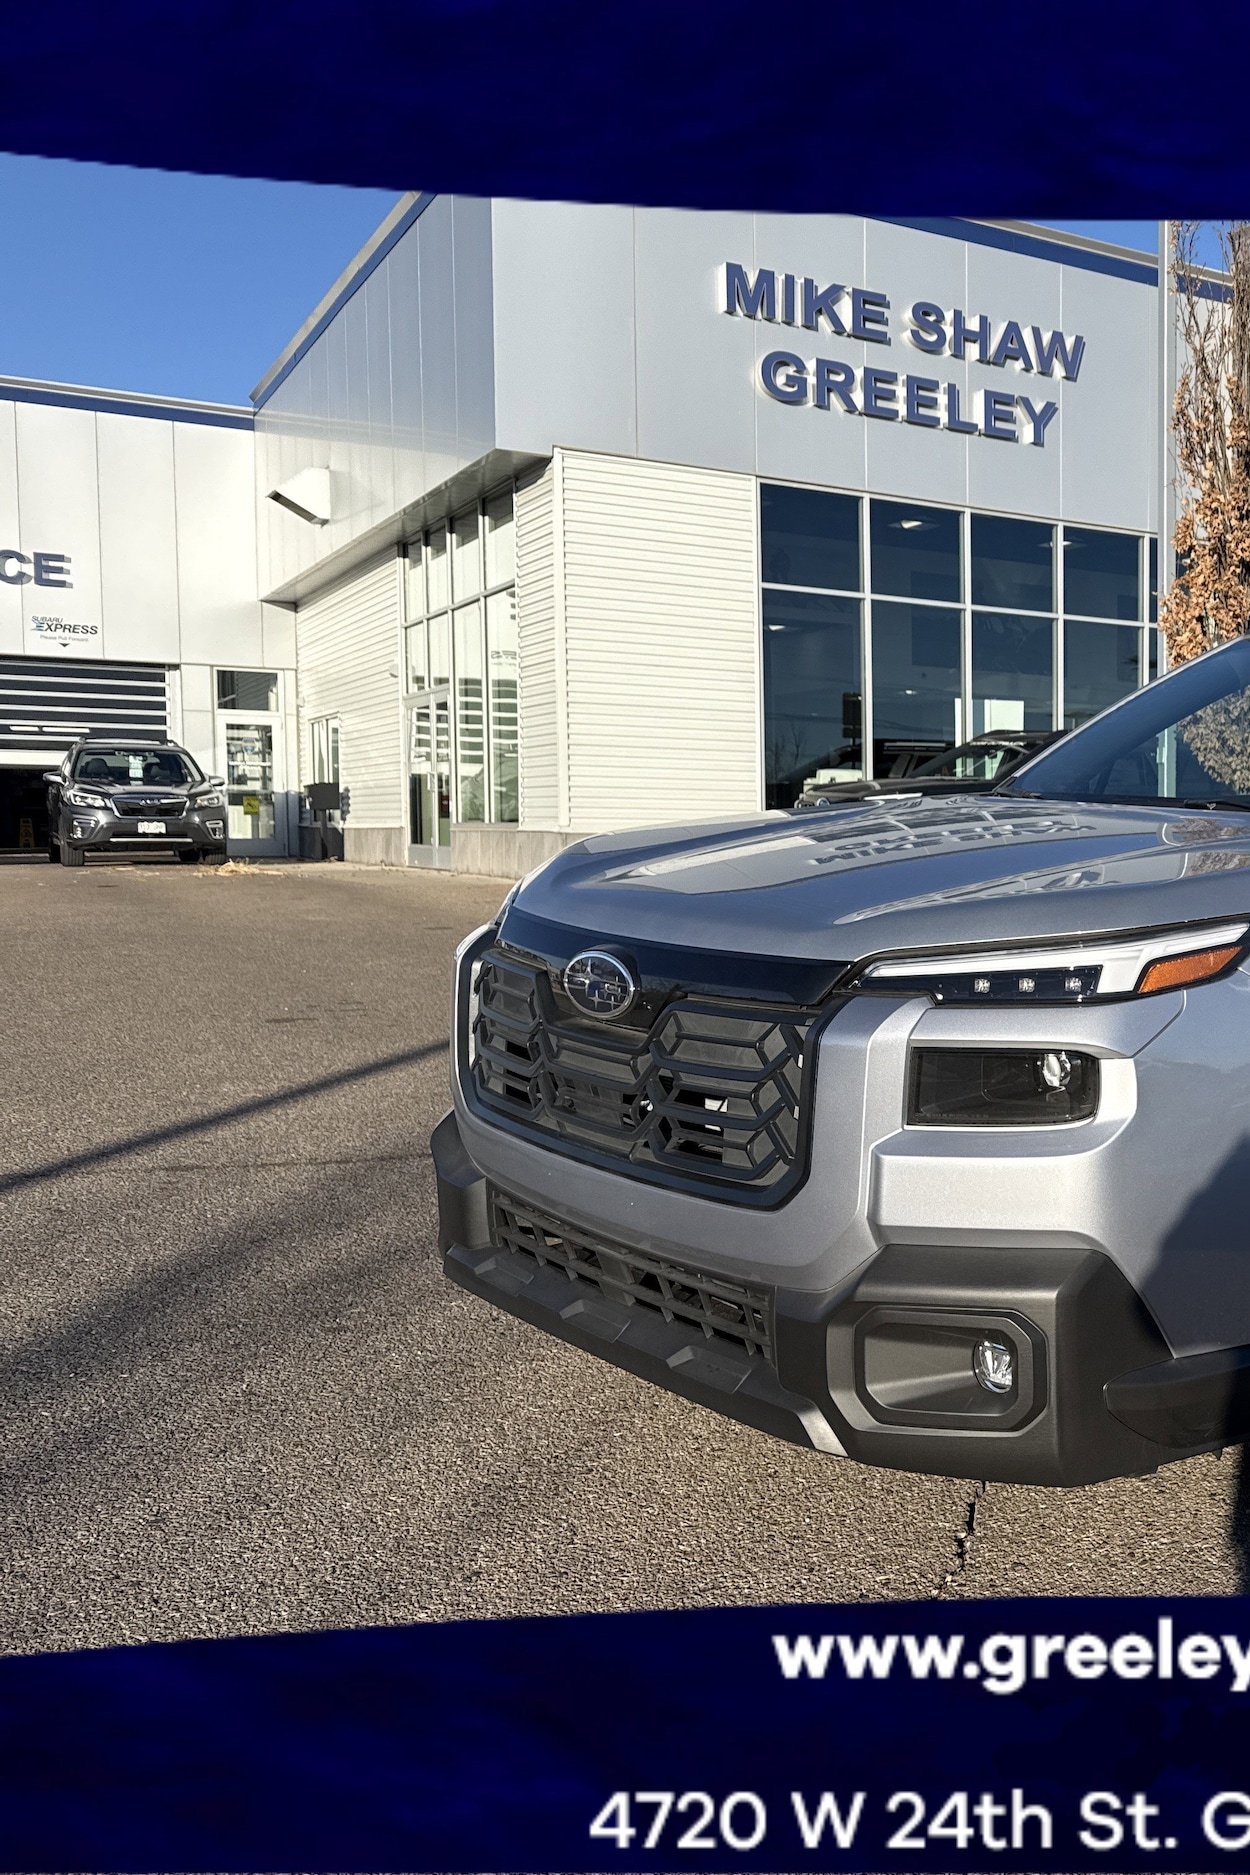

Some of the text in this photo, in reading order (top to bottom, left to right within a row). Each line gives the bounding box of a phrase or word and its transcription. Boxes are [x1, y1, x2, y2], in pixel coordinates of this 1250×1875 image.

[722, 261, 1087, 382] MIKE SHAW
[759, 350, 1059, 447] GREELEY
[31, 615, 63, 623] SUBARU
[31, 621, 98, 635] EXPRESS
